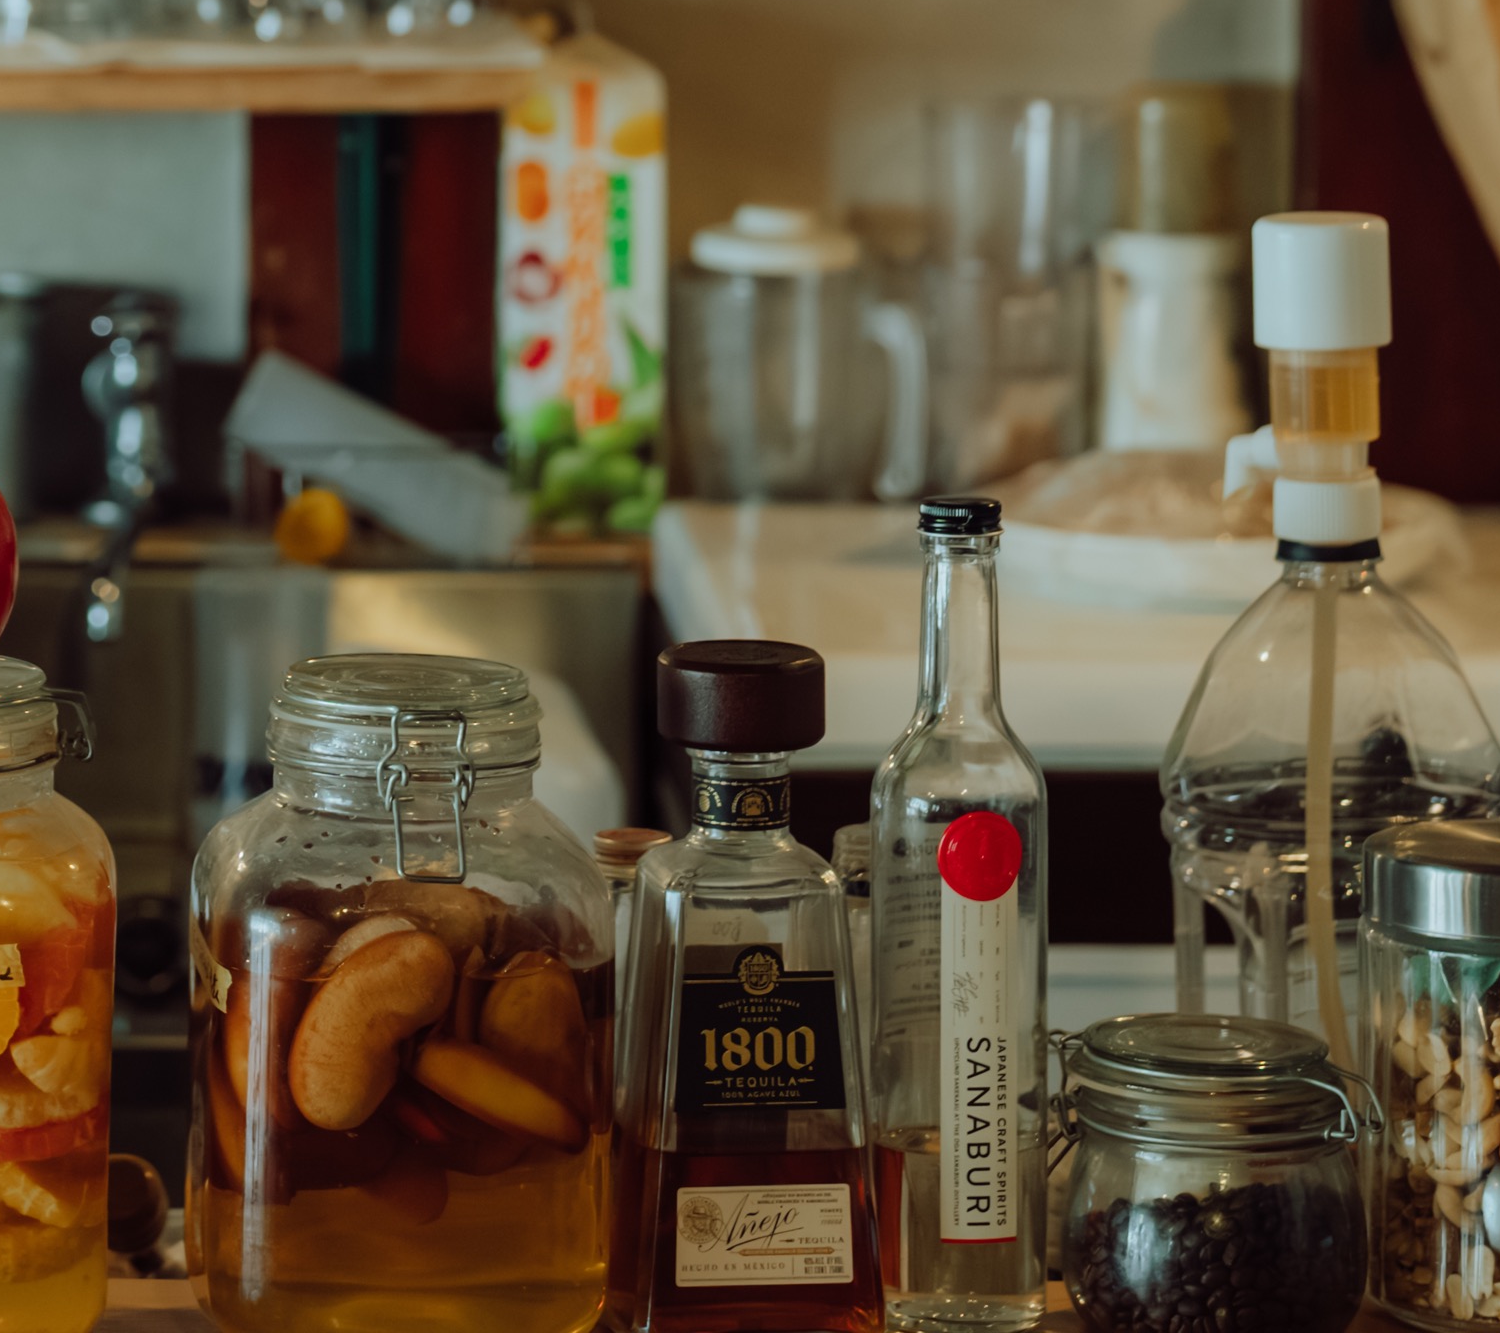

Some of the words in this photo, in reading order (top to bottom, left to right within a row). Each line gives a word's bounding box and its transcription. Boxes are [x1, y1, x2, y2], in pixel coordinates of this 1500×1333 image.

[700, 1026, 815, 1071] 1800
[725, 1077, 797, 1088] TEQUILA
[997, 1036, 1007, 1111] JAPANESE
[966, 1037, 991, 1227] SANABURI
[997, 1117, 1007, 1164] CRAFT
[997, 1171, 1007, 1227] SPIRITS
[698, 1193, 800, 1253] Añejo
[798, 1236, 844, 1244] TEQUILA
[681, 1263, 718, 1272] HECHO
